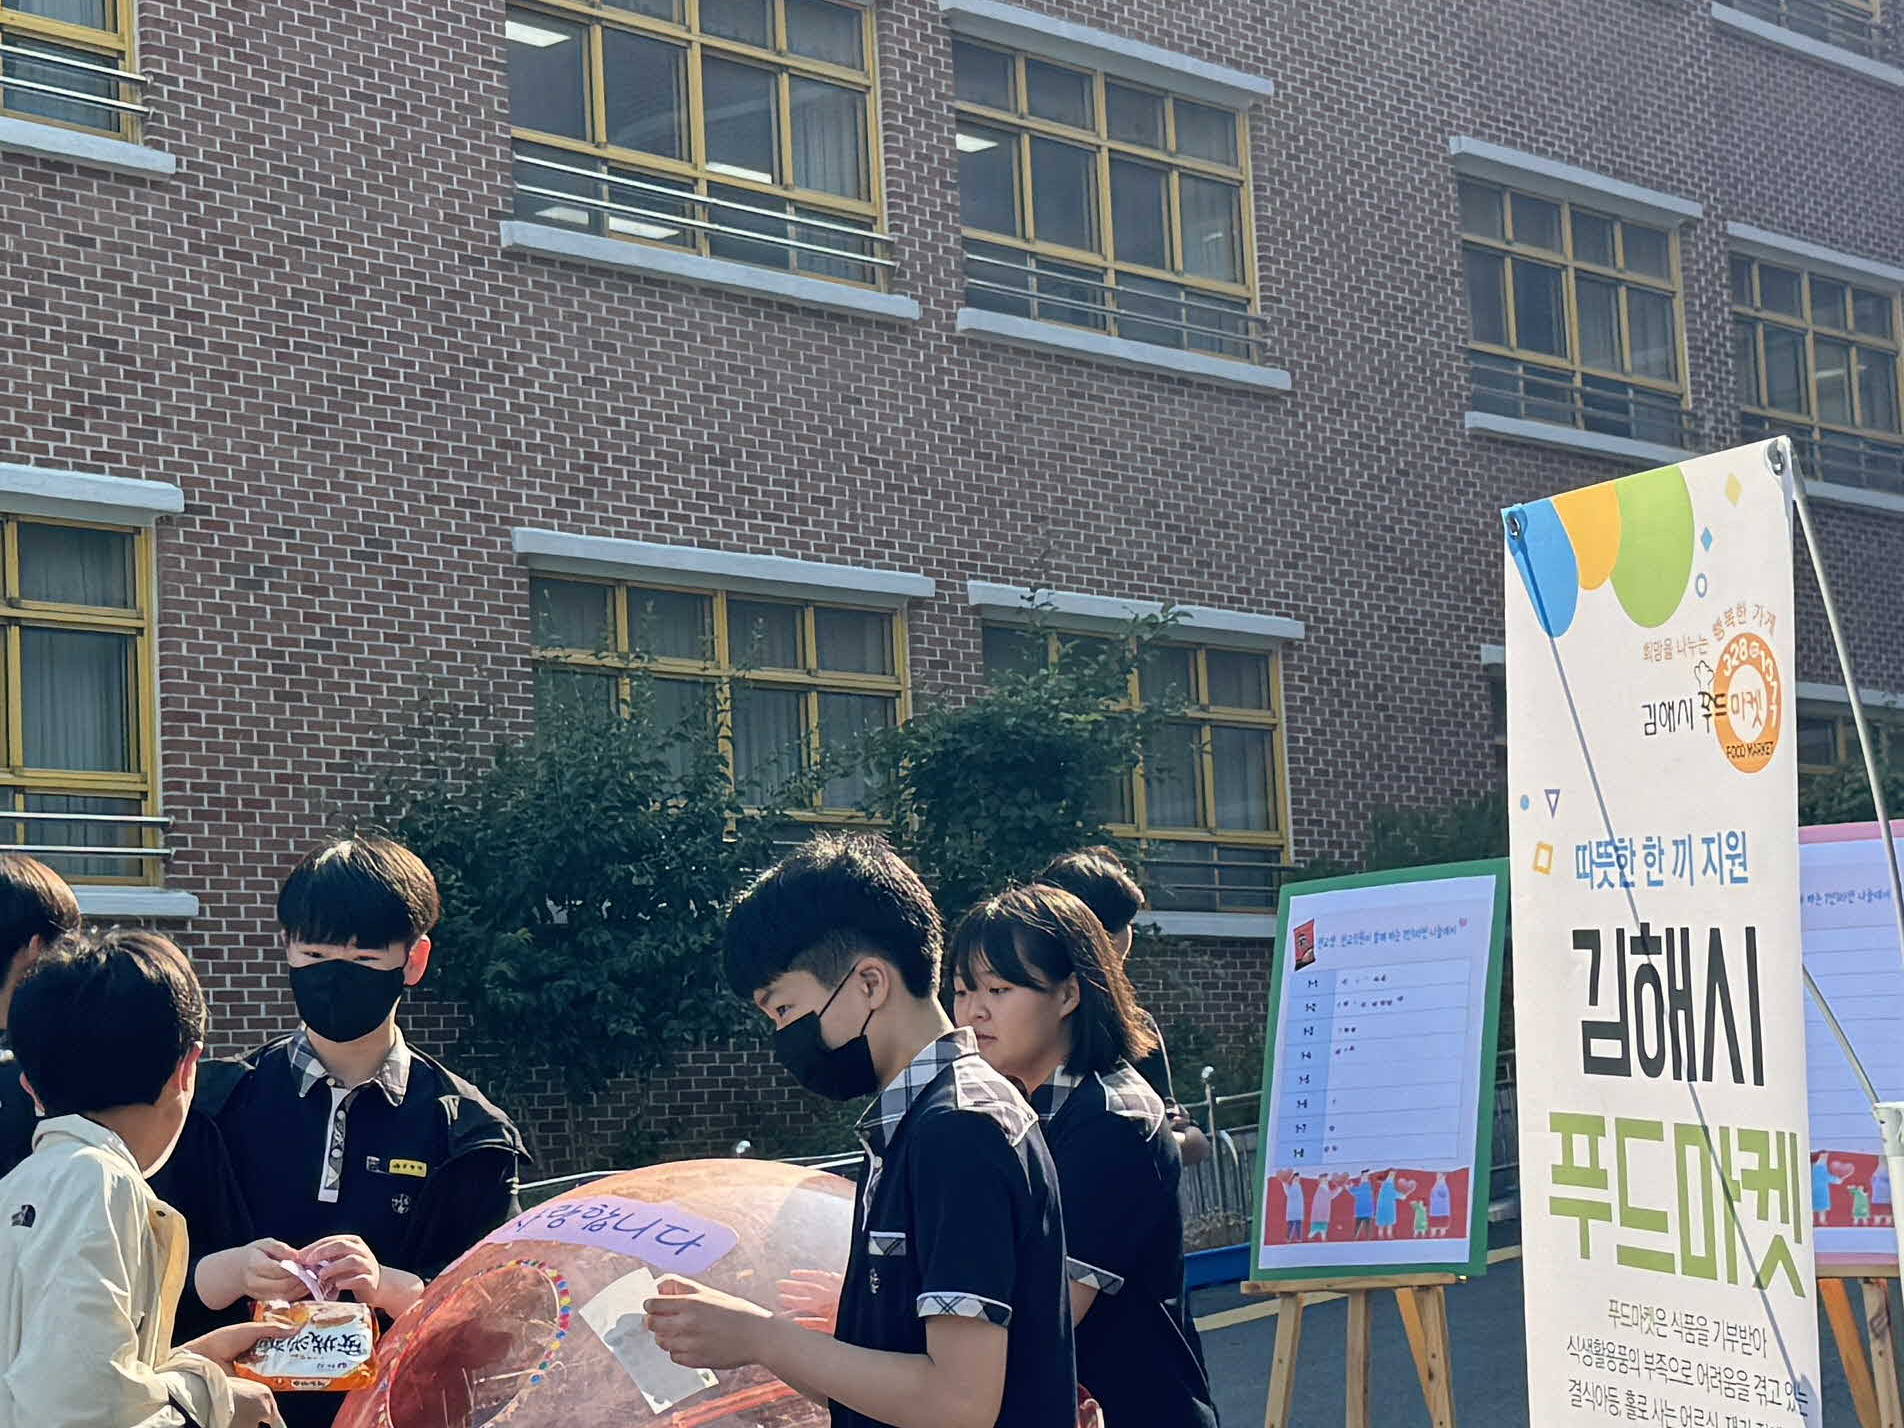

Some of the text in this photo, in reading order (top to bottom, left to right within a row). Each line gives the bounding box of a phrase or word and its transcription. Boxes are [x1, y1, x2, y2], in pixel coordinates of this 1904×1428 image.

[1575, 830, 1749, 891] 따뜻한 한 끼 지원
[1571, 921, 1765, 1088] 김해시
[1549, 1110, 1806, 1298] 푸드마켓
[1607, 1299, 1768, 1359] 푸드마켓은 식품을 기부받아
[1643, 1346, 1695, 1388] 부족으로
[1696, 1361, 1751, 1403] 어려움을
